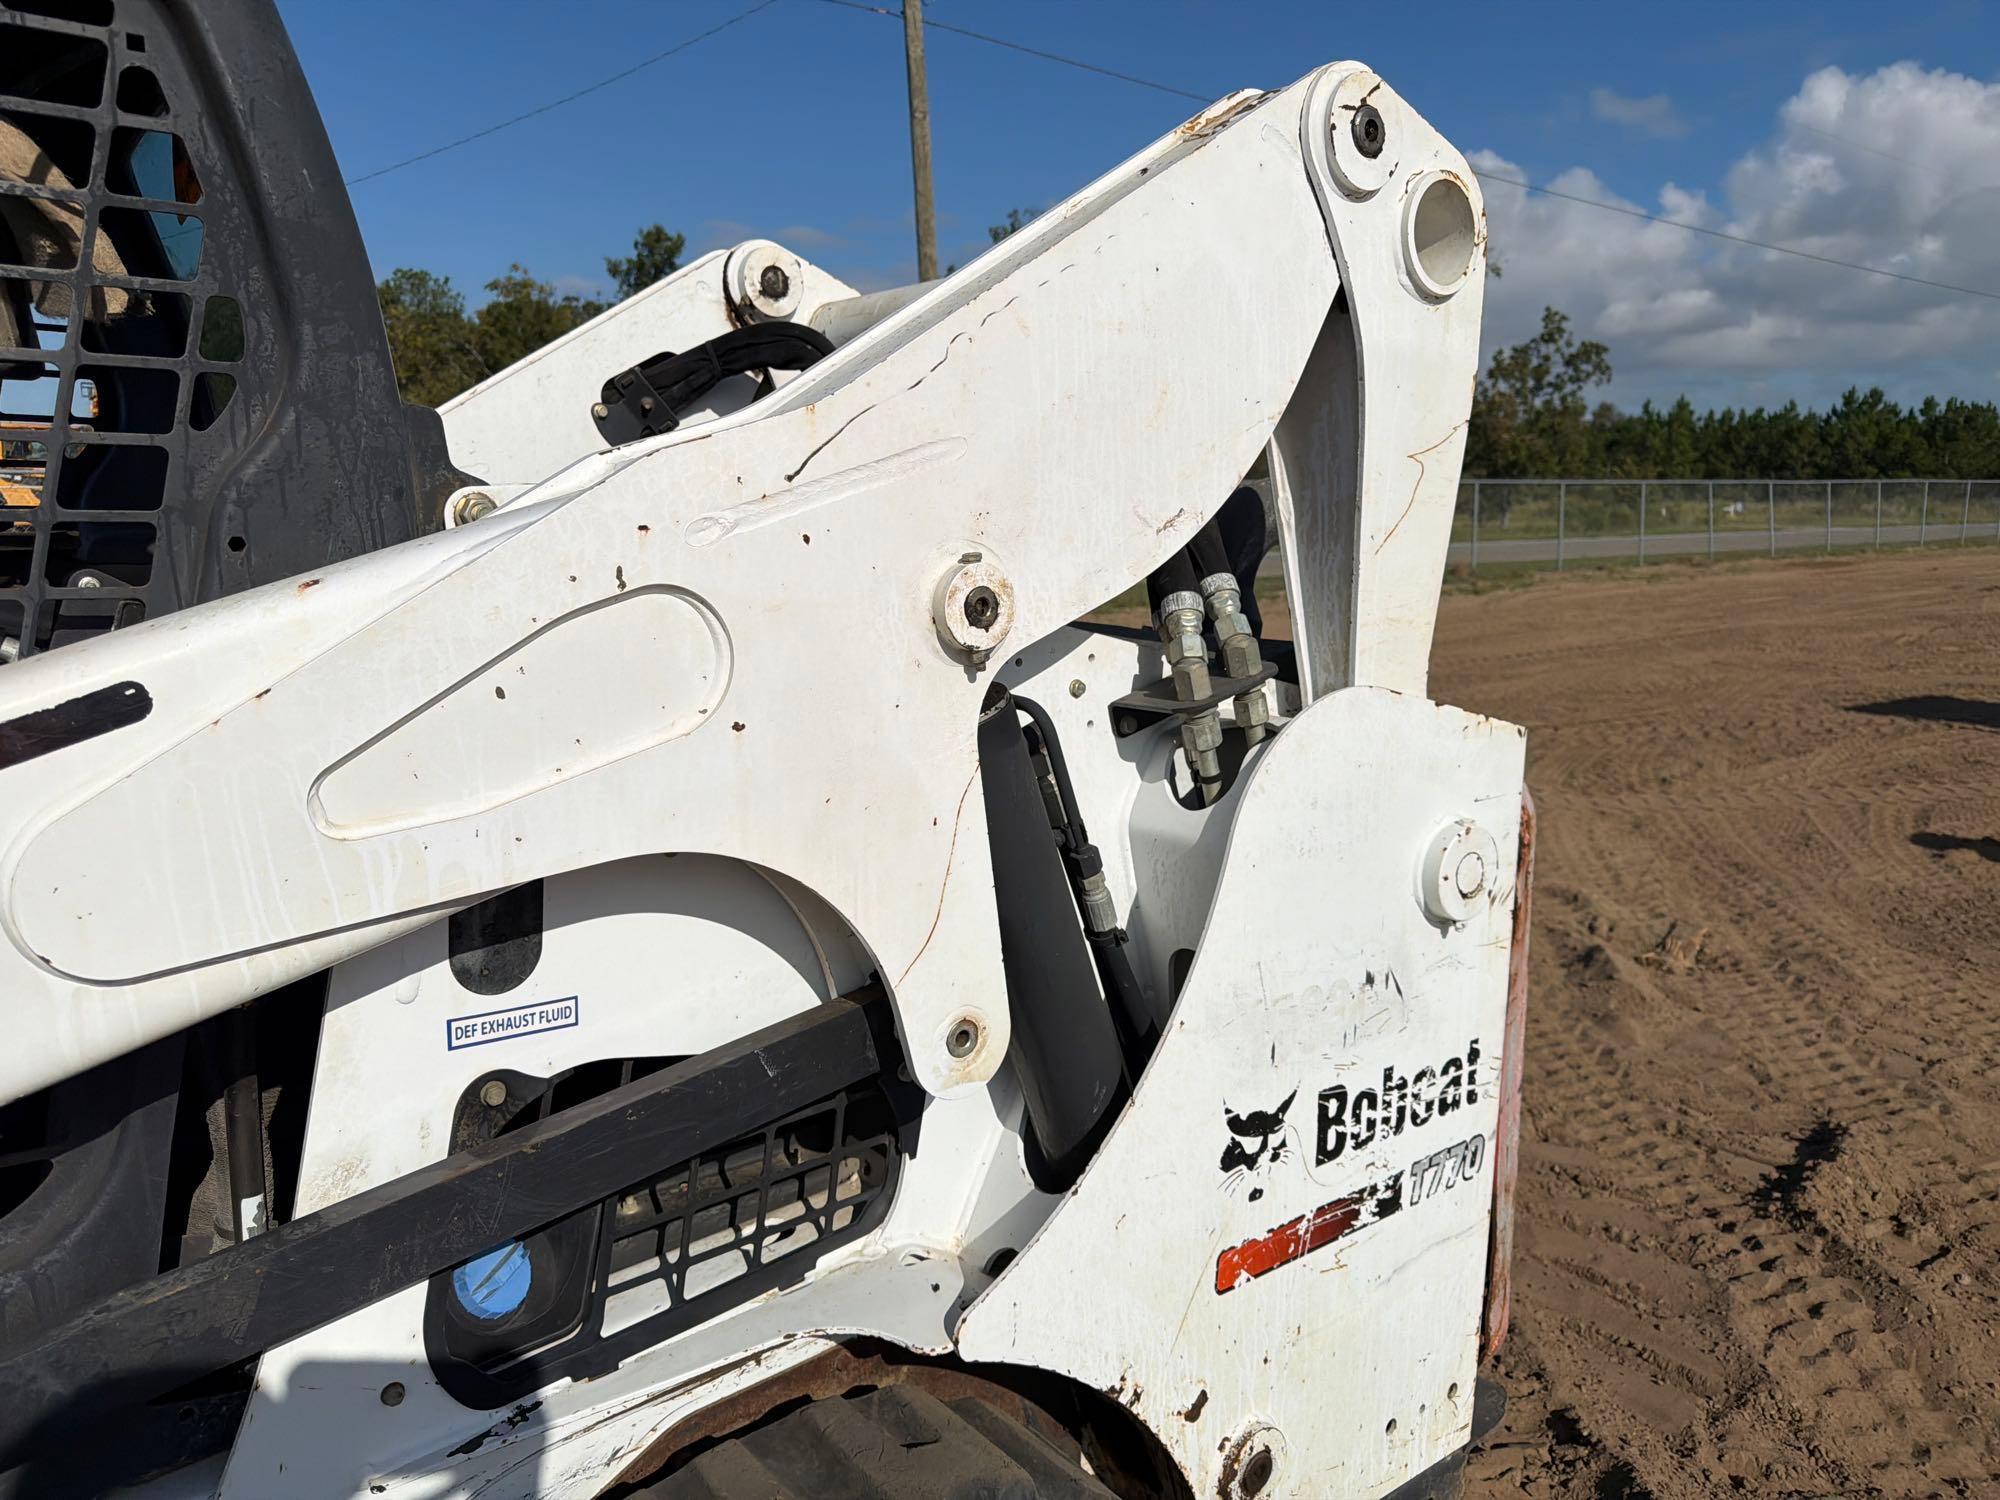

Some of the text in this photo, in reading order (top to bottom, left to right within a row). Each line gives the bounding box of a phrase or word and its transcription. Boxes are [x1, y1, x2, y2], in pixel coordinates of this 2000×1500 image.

[455, 1004, 572, 1041] DEF EXHAUST FLUID
[1316, 1038, 1480, 1168] Bobcat
[1410, 1134, 1486, 1206] T770
